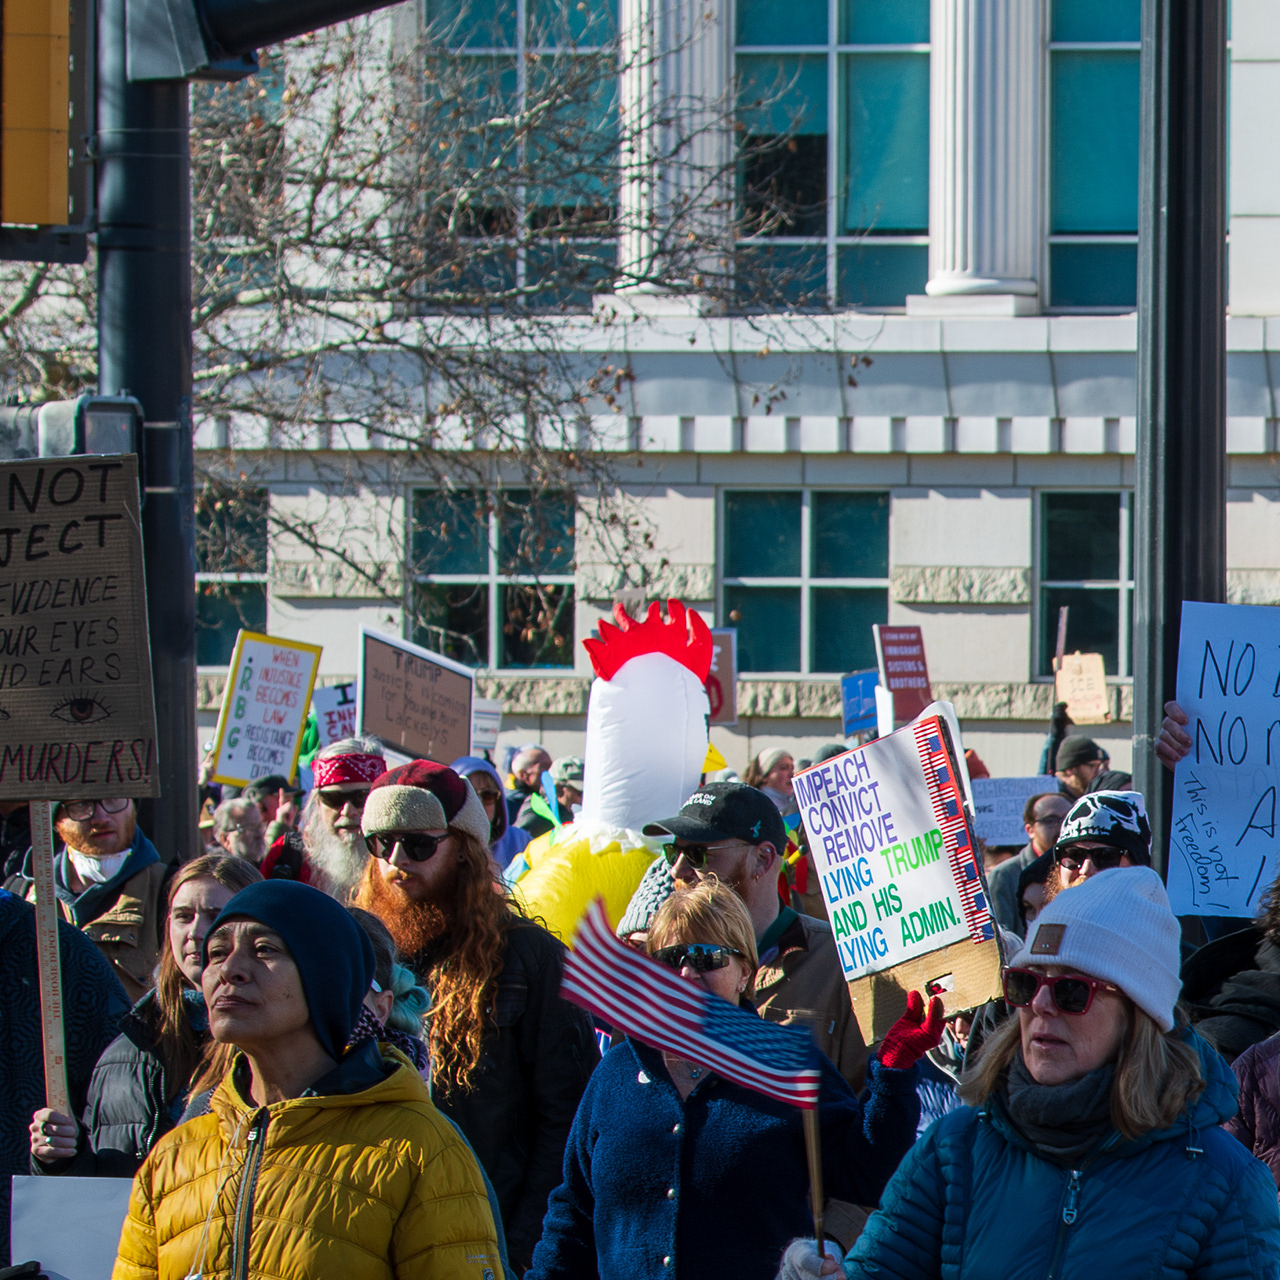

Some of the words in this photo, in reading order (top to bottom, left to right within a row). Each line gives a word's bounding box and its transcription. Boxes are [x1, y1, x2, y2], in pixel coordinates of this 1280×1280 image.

[8, 462, 124, 513] NOT
[51, 616, 120, 652] EYES
[38, 652, 121, 686] EARS
[258, 666, 304, 689] INJUSTICE
[272, 647, 300, 667] WHEN
[392, 650, 442, 682] TRUMP
[1199, 640, 1255, 699] NO
[254, 684, 300, 709] BECOMES
[262, 706, 288, 725] LAW
[244, 723, 295, 749] RESISTANCE
[246, 743, 285, 766] BECOMES
[1196, 711, 1248, 766] NO
[0, 738, 152, 785] MURDERS!
[794, 750, 870, 810] IMPEACH
[808, 781, 883, 835] CONVICT
[1184, 770, 1207, 816] This
[1209, 845, 1239, 887] not
[822, 812, 898, 866] REMOVE
[823, 857, 874, 904] LYING
[880, 828, 944, 878] TRUMP
[832, 900, 867, 941] AND
[872, 883, 902, 922] HIS
[48, 927, 58, 963] DEPOT
[837, 927, 890, 973] LYING
[900, 896, 961, 947] ADMIN.
[50, 965, 60, 997] HOME
